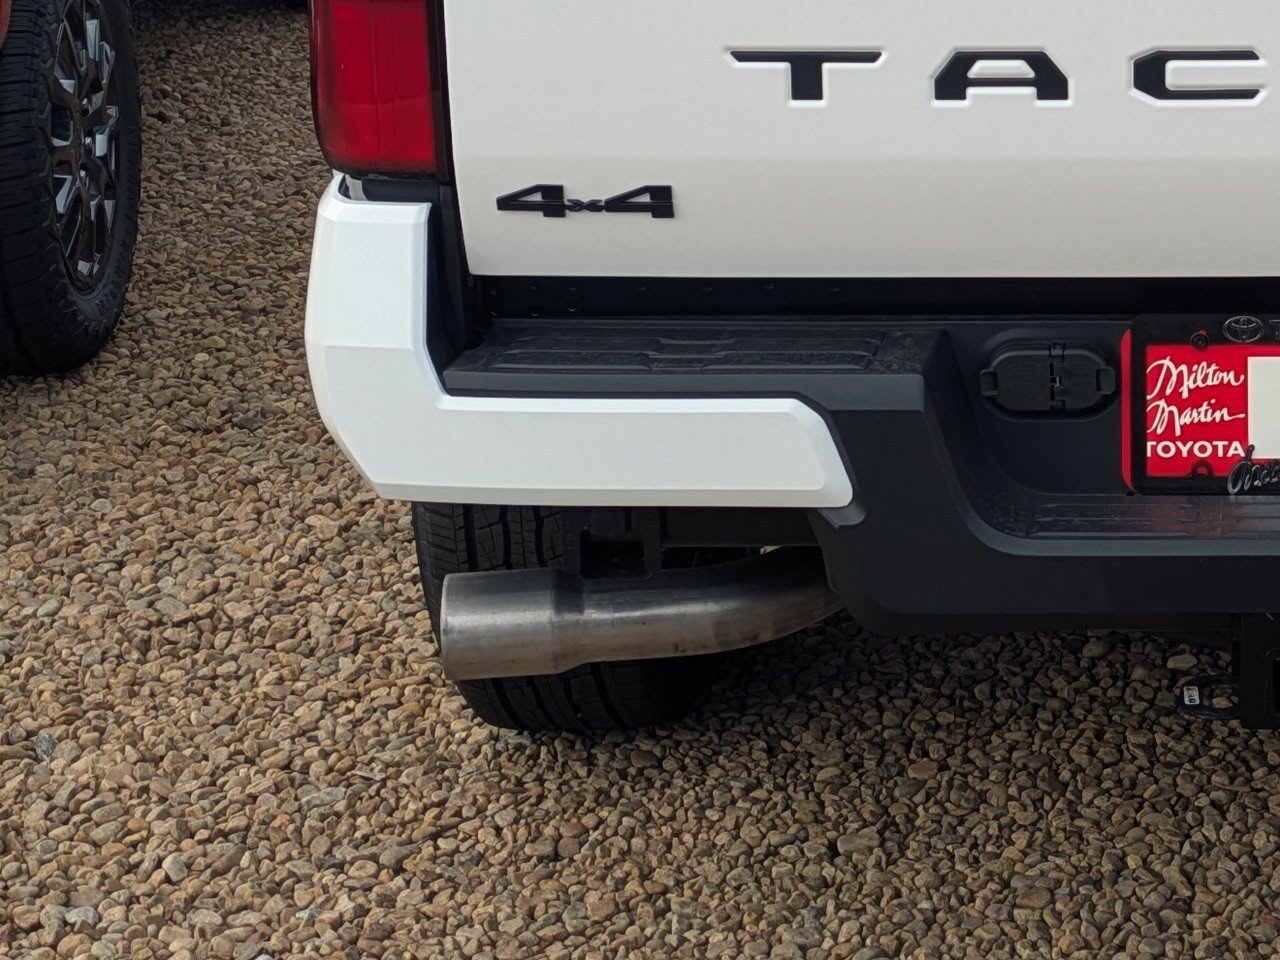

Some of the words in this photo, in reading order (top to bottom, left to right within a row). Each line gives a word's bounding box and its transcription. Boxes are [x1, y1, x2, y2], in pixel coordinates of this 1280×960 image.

[496, 183, 675, 219] 4x4
[1146, 355, 1245, 400] Milton
[1146, 399, 1245, 437] Martin
[1146, 440, 1246, 458] TOYOTA
